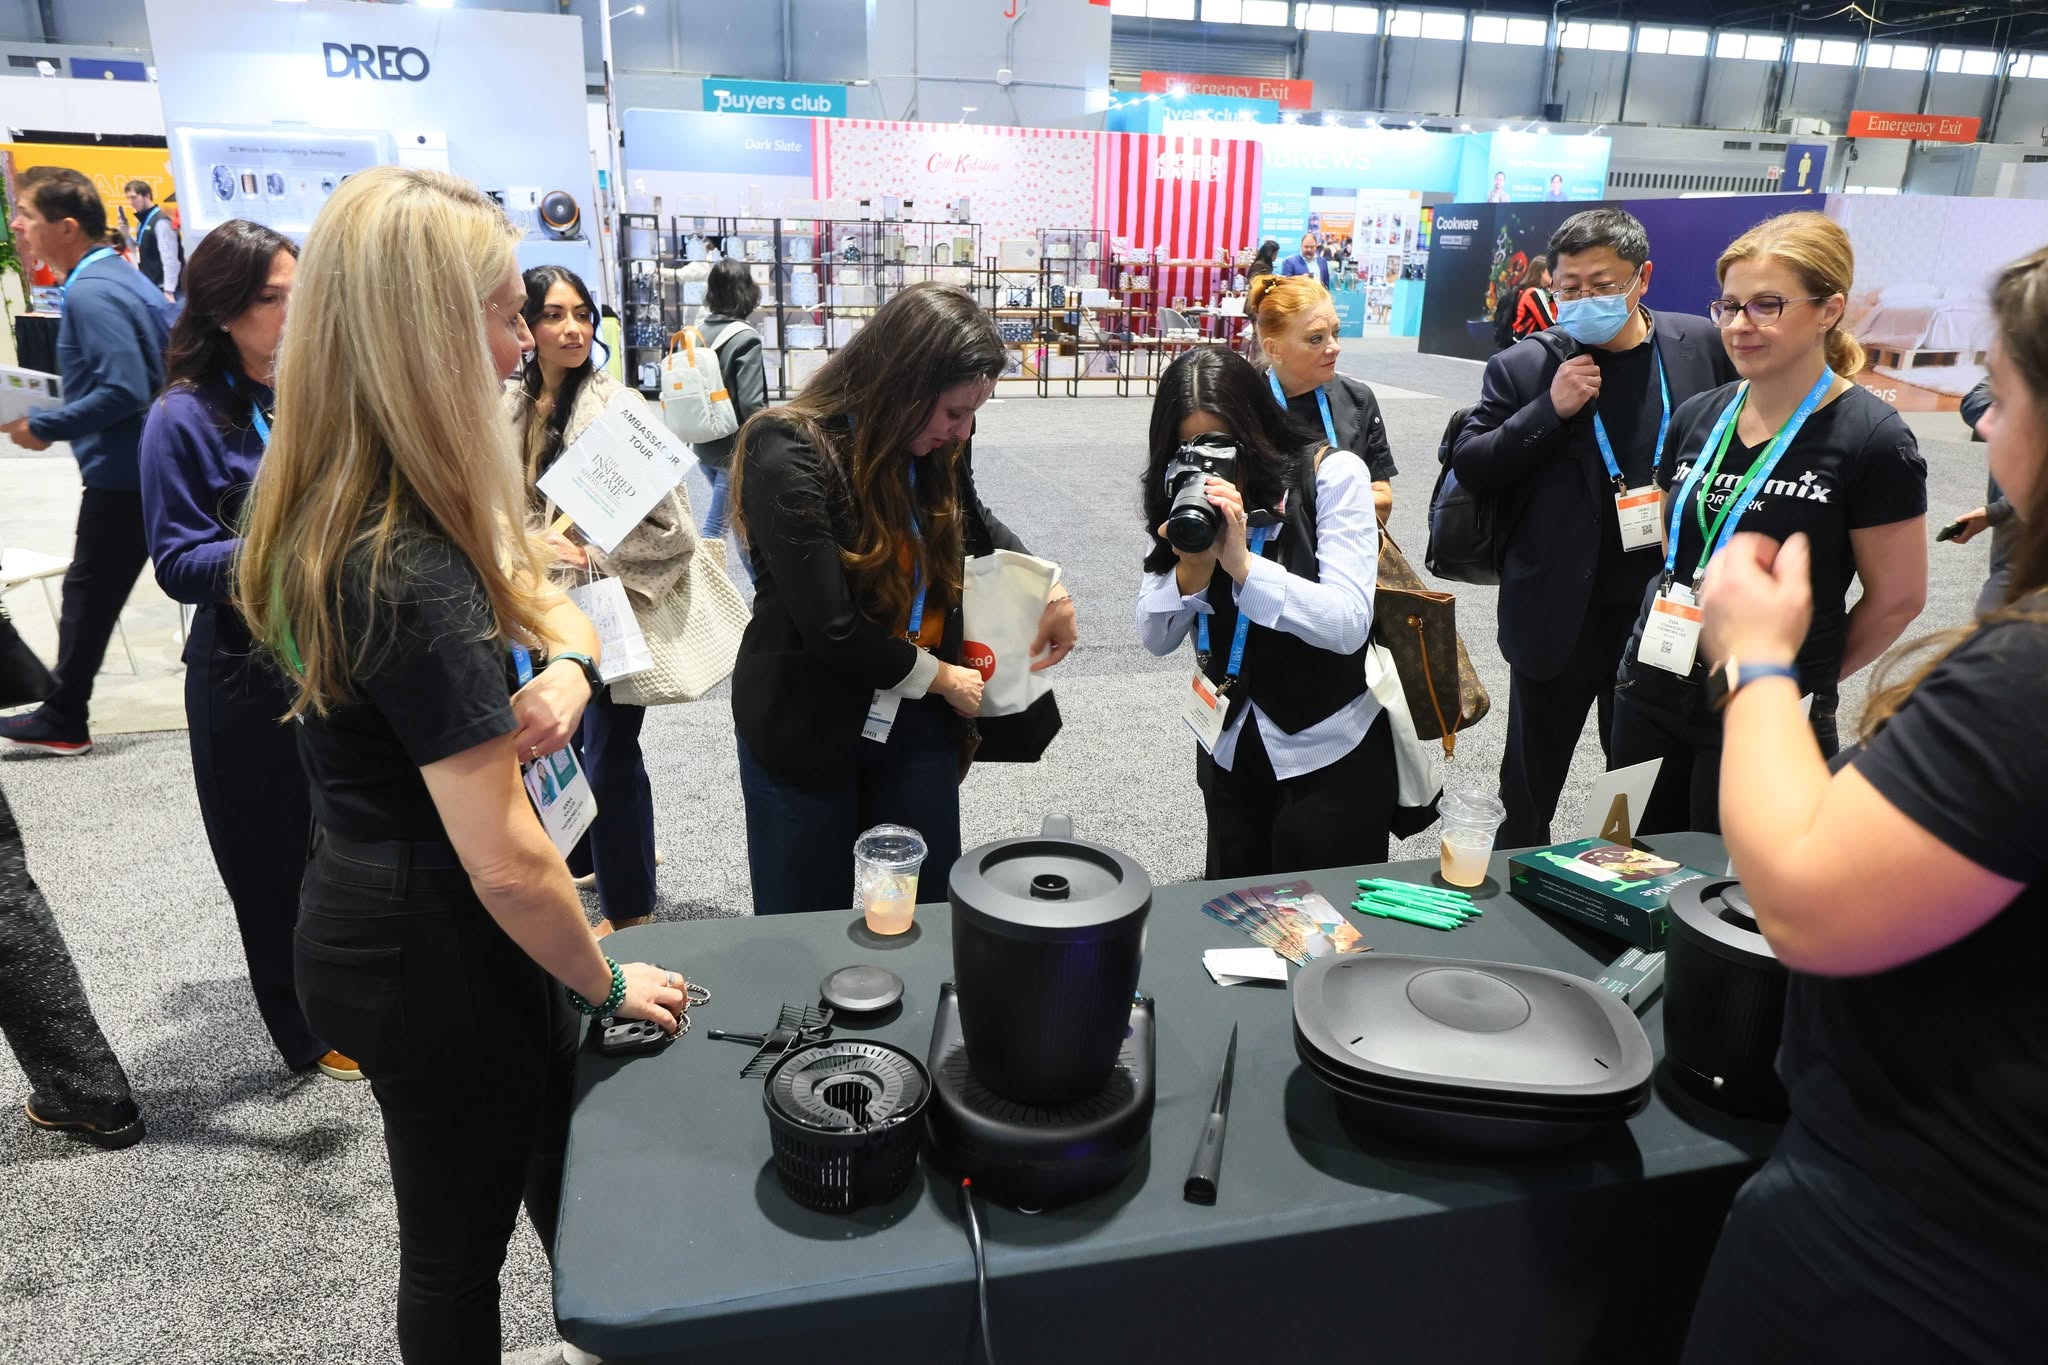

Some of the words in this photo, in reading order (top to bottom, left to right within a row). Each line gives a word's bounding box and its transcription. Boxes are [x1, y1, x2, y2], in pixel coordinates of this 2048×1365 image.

[322, 42, 430, 82] DREO
[1165, 77, 1252, 97] Eergency
[1259, 82, 1290, 100] Exit
[719, 93, 785, 112] buyers
[791, 93, 831, 112] club
[1867, 116, 1935, 136] Emergency
[1939, 120, 1963, 135] Exit
[744, 138, 772, 151] Dark
[775, 140, 803, 153] Slate
[1436, 216, 1479, 231] Cookware
[629, 434, 654, 461] TOUR
[592, 453, 636, 498] INSPIRED
[592, 466, 625, 500] HOME
[1672, 461, 1832, 503] thrmmix
